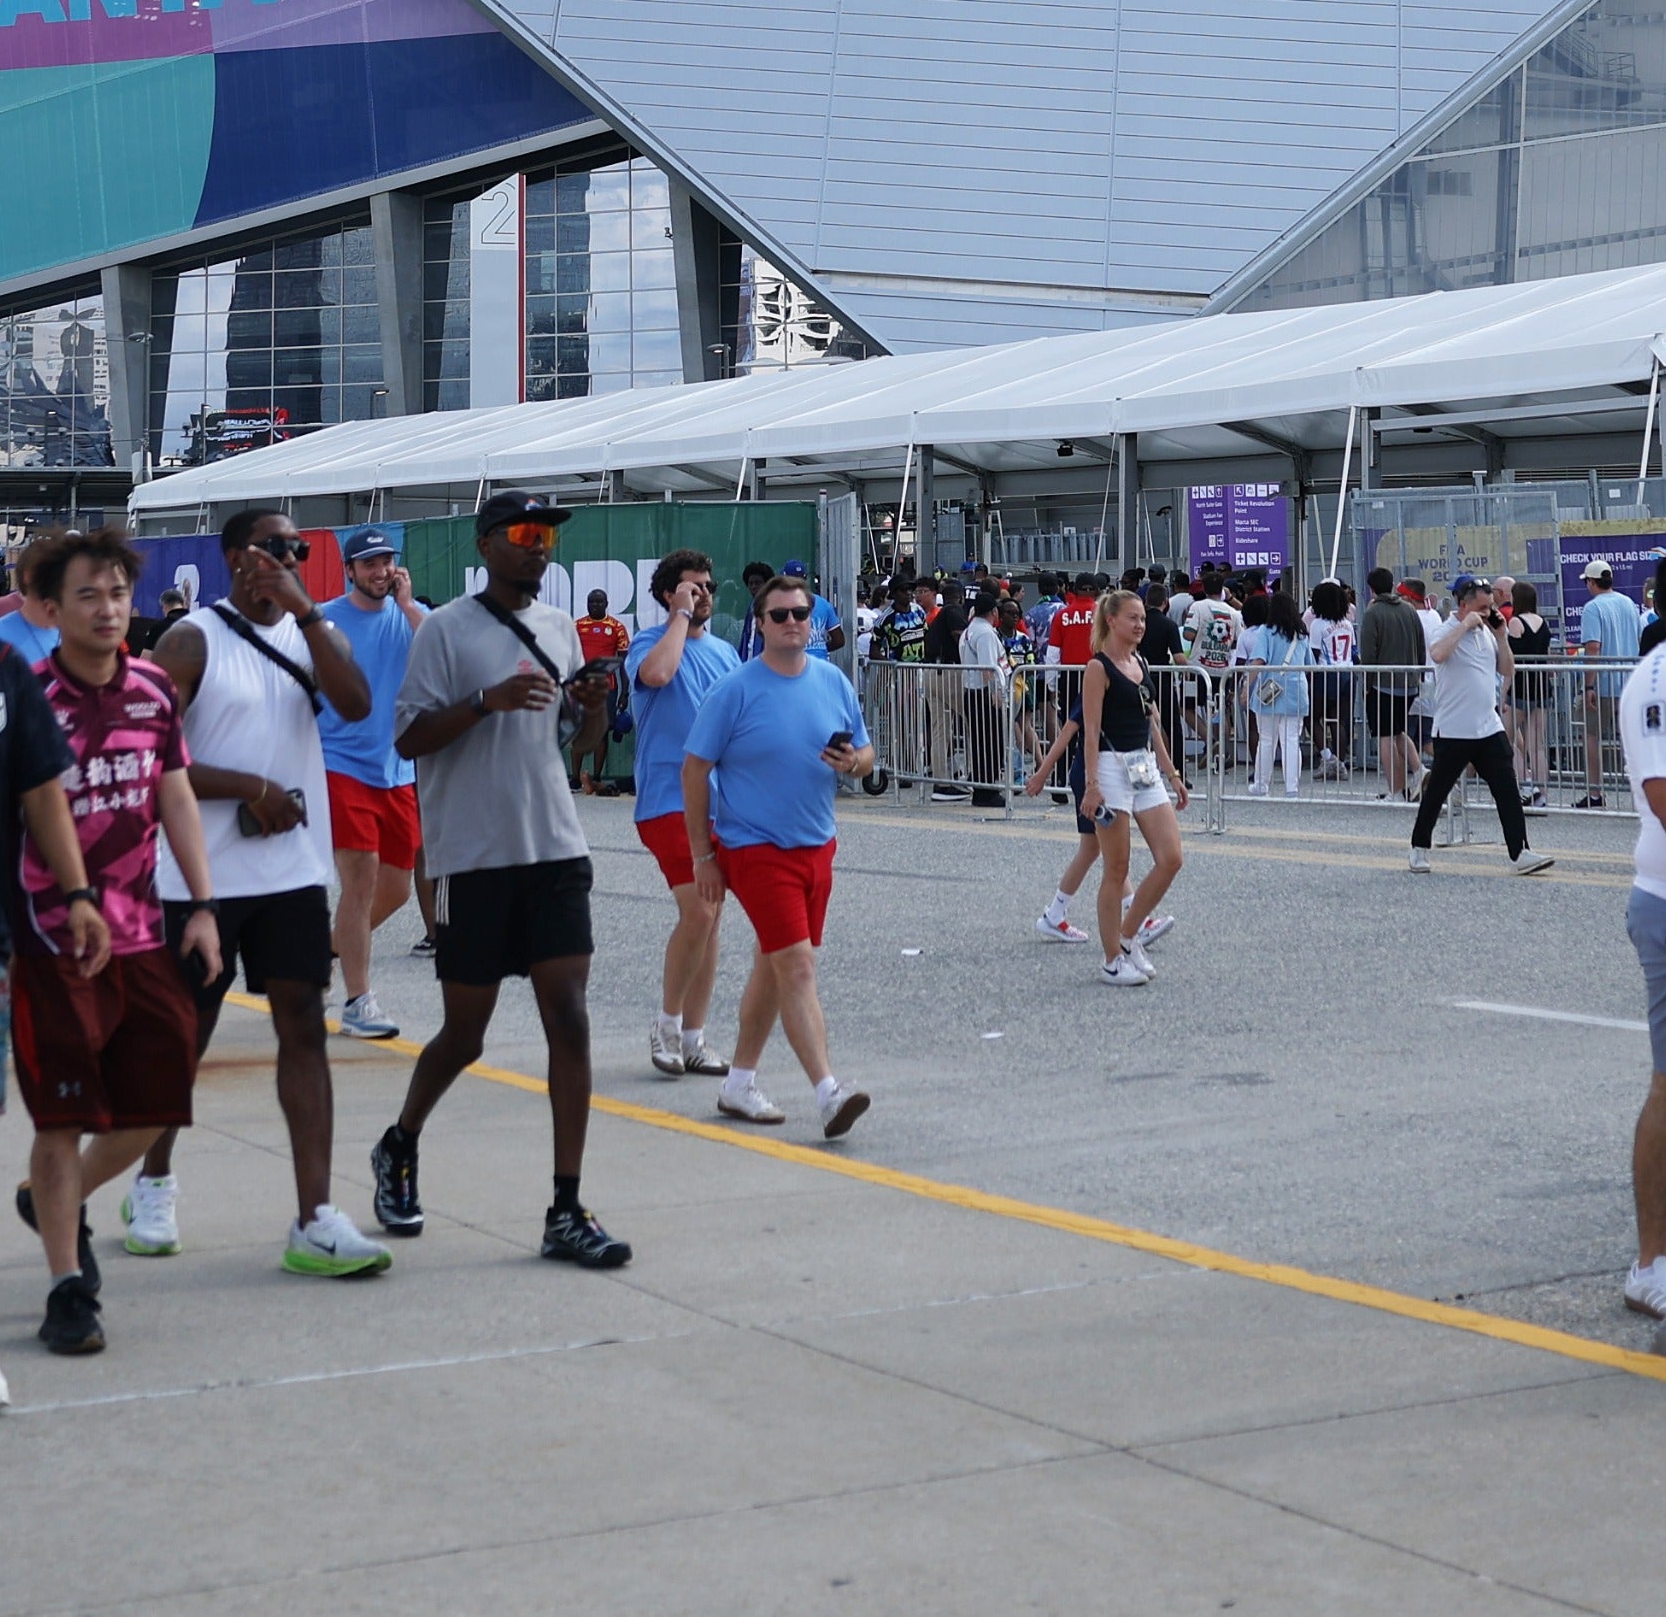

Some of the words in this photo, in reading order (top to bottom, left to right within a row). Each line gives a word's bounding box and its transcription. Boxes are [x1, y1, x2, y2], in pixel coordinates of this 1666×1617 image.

[1464, 556, 1488, 568] CUP
[1560, 553, 1590, 564] CHECK
[1590, 552, 1614, 562] YOUR
[1615, 551, 1638, 562] FLAG
[1062, 610, 1093, 626] S.A.F.
[1565, 606, 1583, 617] CHE
[1332, 634, 1350, 661] 17
